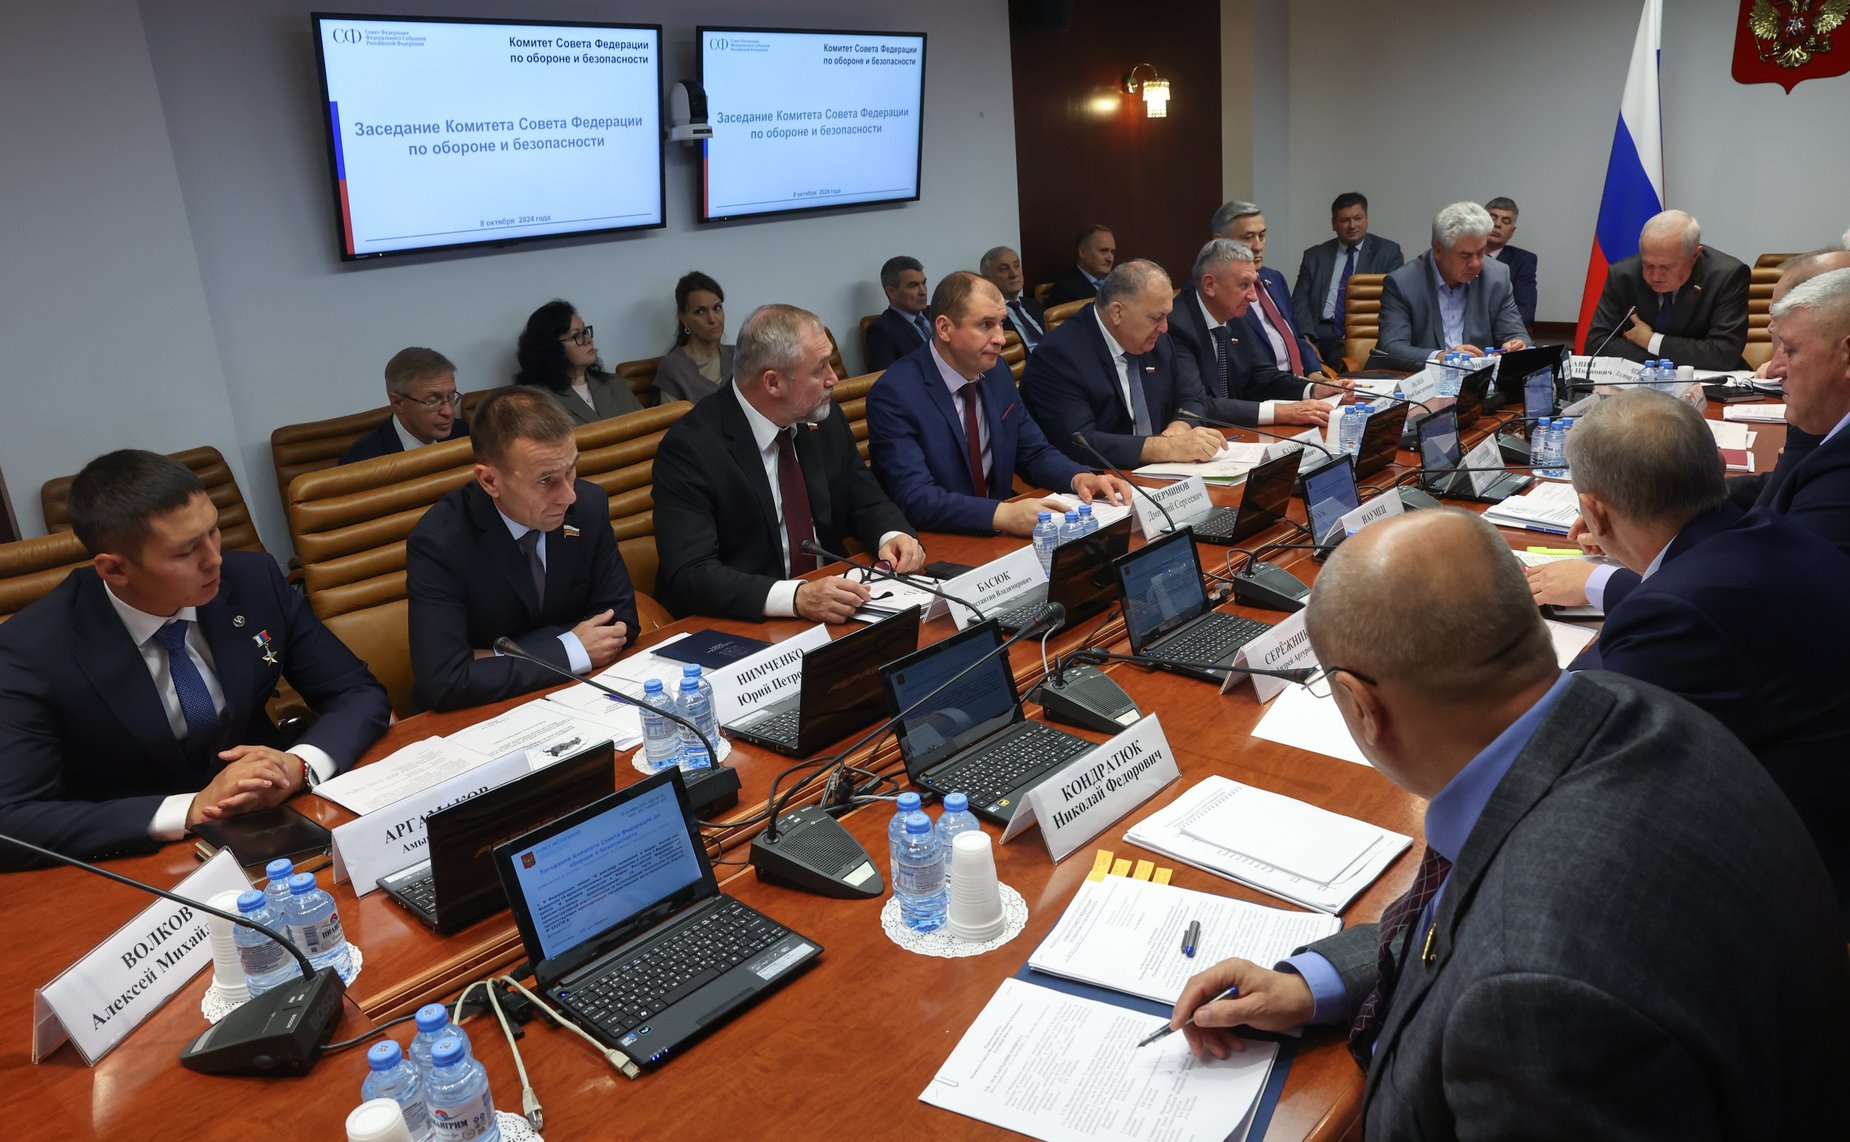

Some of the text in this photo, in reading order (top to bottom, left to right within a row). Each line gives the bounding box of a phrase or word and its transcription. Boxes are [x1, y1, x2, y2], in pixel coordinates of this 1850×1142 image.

[509, 36, 649, 51] Комитет Совета Федерации
[823, 44, 918, 55] Комитет Совета Федерации
[510, 53, 649, 65] по обороне и безопасности
[834, 56, 864, 66] обороне
[872, 56, 916, 66] безопасности
[354, 115, 643, 138] Заседание Комитета Совета Федерации
[717, 108, 909, 124] Заседание Комитета Совета Федерации
[750, 130, 764, 140] по
[766, 128, 808, 140] обороне
[820, 125, 882, 136] безопасности
[408, 135, 606, 157] по обороне и безопасности
[480, 214, 551, 228] 8 октября 2024 года
[1148, 502, 1175, 522] Дмирий
[976, 570, 1011, 592] БАСЮК
[736, 648, 804, 686] НИМЧЕНКО
[737, 683, 772, 706] Юрий
[1061, 740, 1142, 802] КОНДРАТЮК
[1052, 750, 1162, 830] Николай Федорович
[402, 836, 428, 854] Амы
[120, 906, 193, 970] ВОЛКОВ
[92, 968, 158, 1031] Алексей
